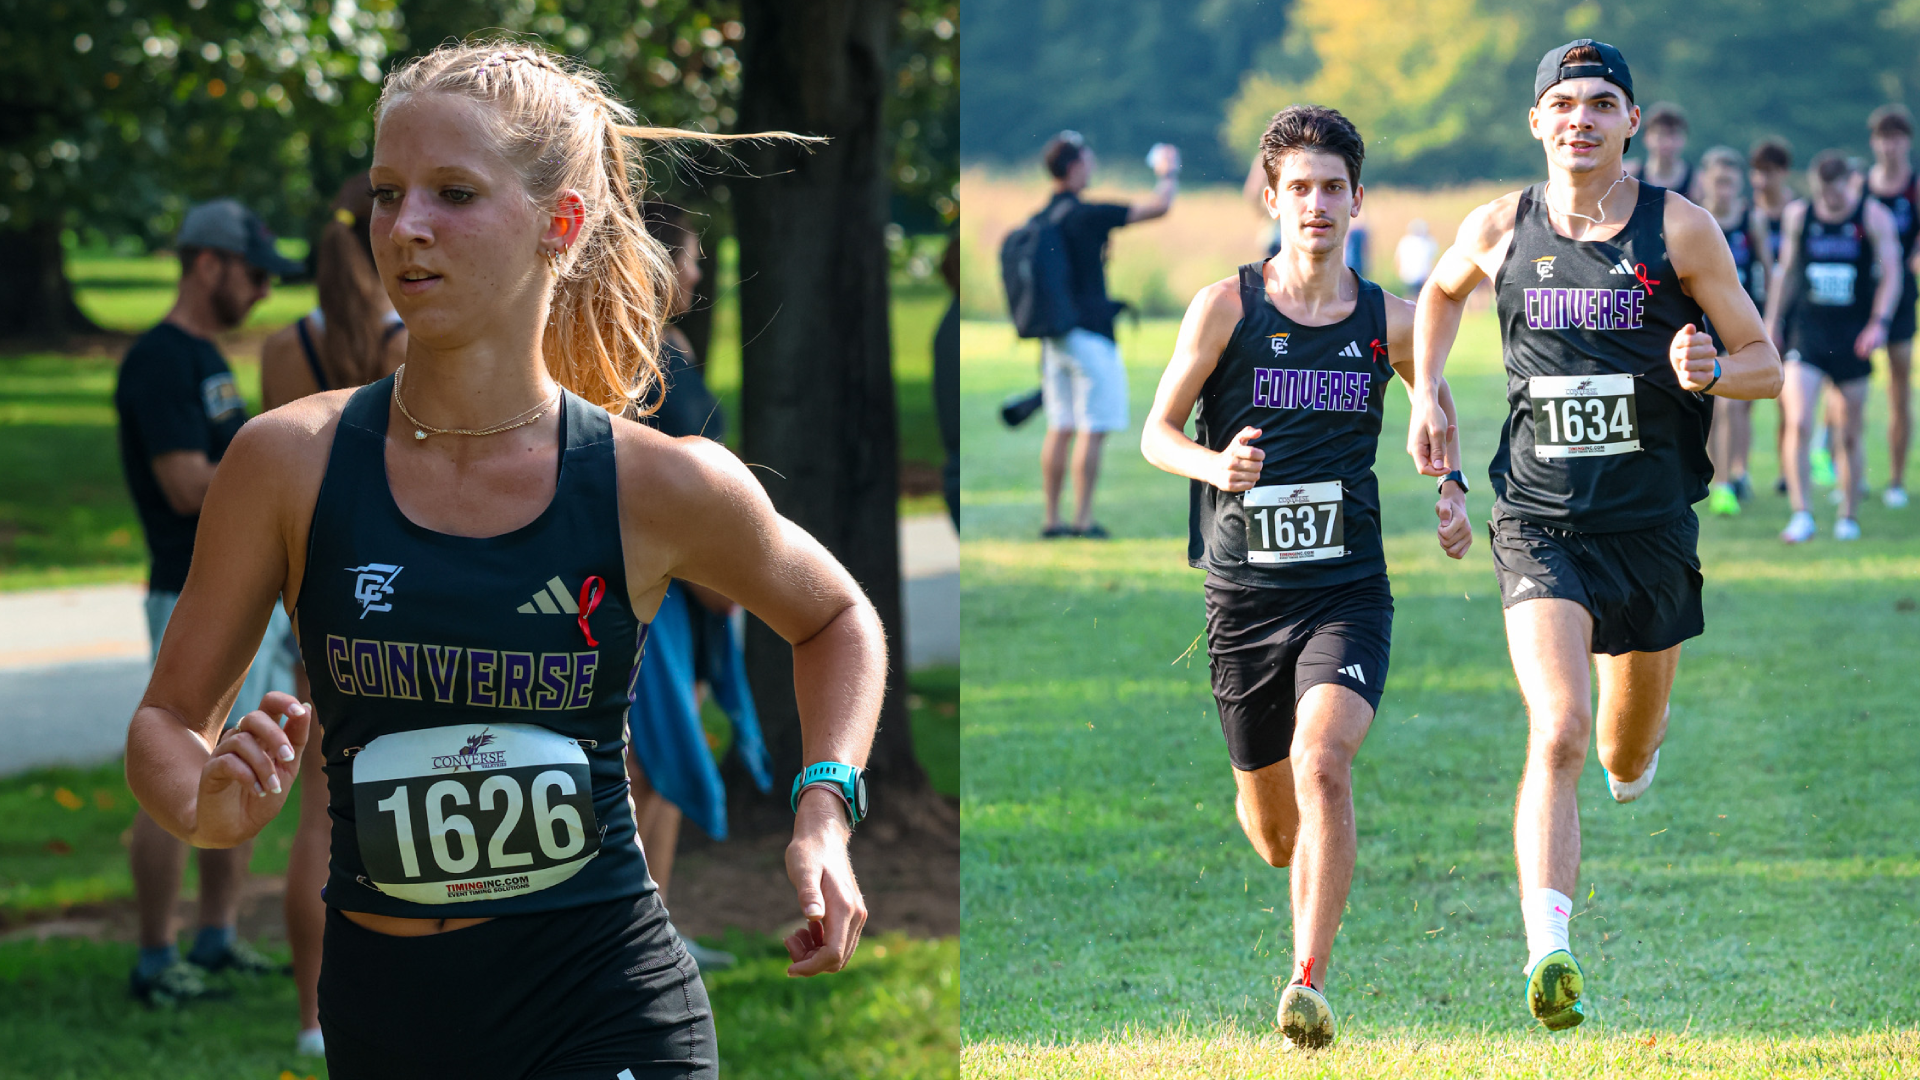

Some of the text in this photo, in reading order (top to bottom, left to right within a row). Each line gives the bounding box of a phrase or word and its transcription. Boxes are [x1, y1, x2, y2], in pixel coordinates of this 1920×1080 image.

[1523, 287, 1645, 330] CONVERSE
[1252, 366, 1372, 412] CONVERSE
[1541, 397, 1633, 443] 1634
[1253, 502, 1339, 550] 1637
[326, 633, 600, 711] CONVERSE
[433, 751, 505, 769] CONVERSE
[377, 769, 587, 879] 1626
[445, 875, 530, 893] TIMINGINC.COM
[447, 883, 531, 898] EVENT TIMING SOLUTIONS
